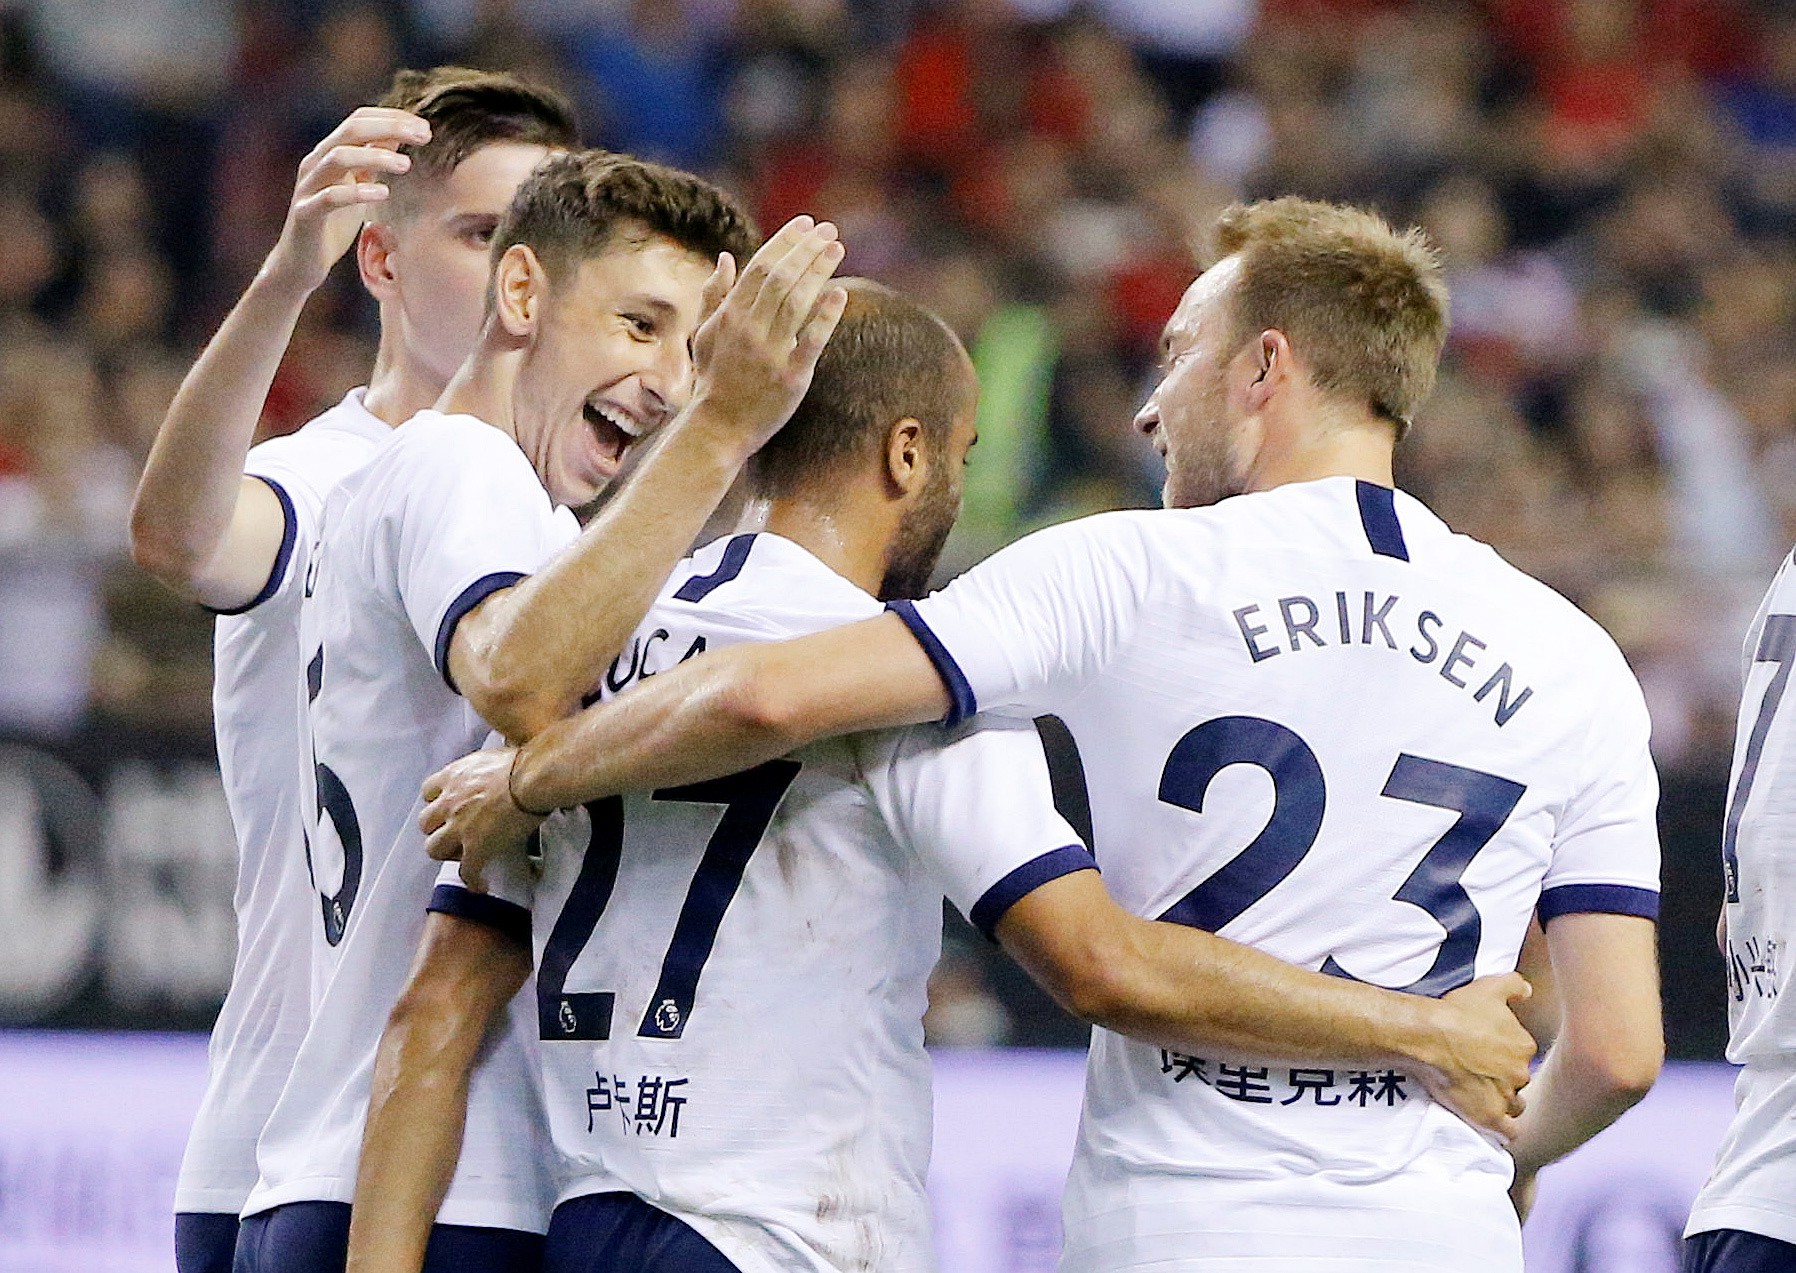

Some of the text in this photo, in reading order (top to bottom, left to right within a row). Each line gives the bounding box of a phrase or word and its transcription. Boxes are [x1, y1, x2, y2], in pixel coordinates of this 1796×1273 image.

[1233, 590, 1534, 728] ERIKSEN
[527, 759, 802, 1041] 27
[1158, 715, 1528, 998] 23
[586, 1070, 689, 1138] 卢卡斯
